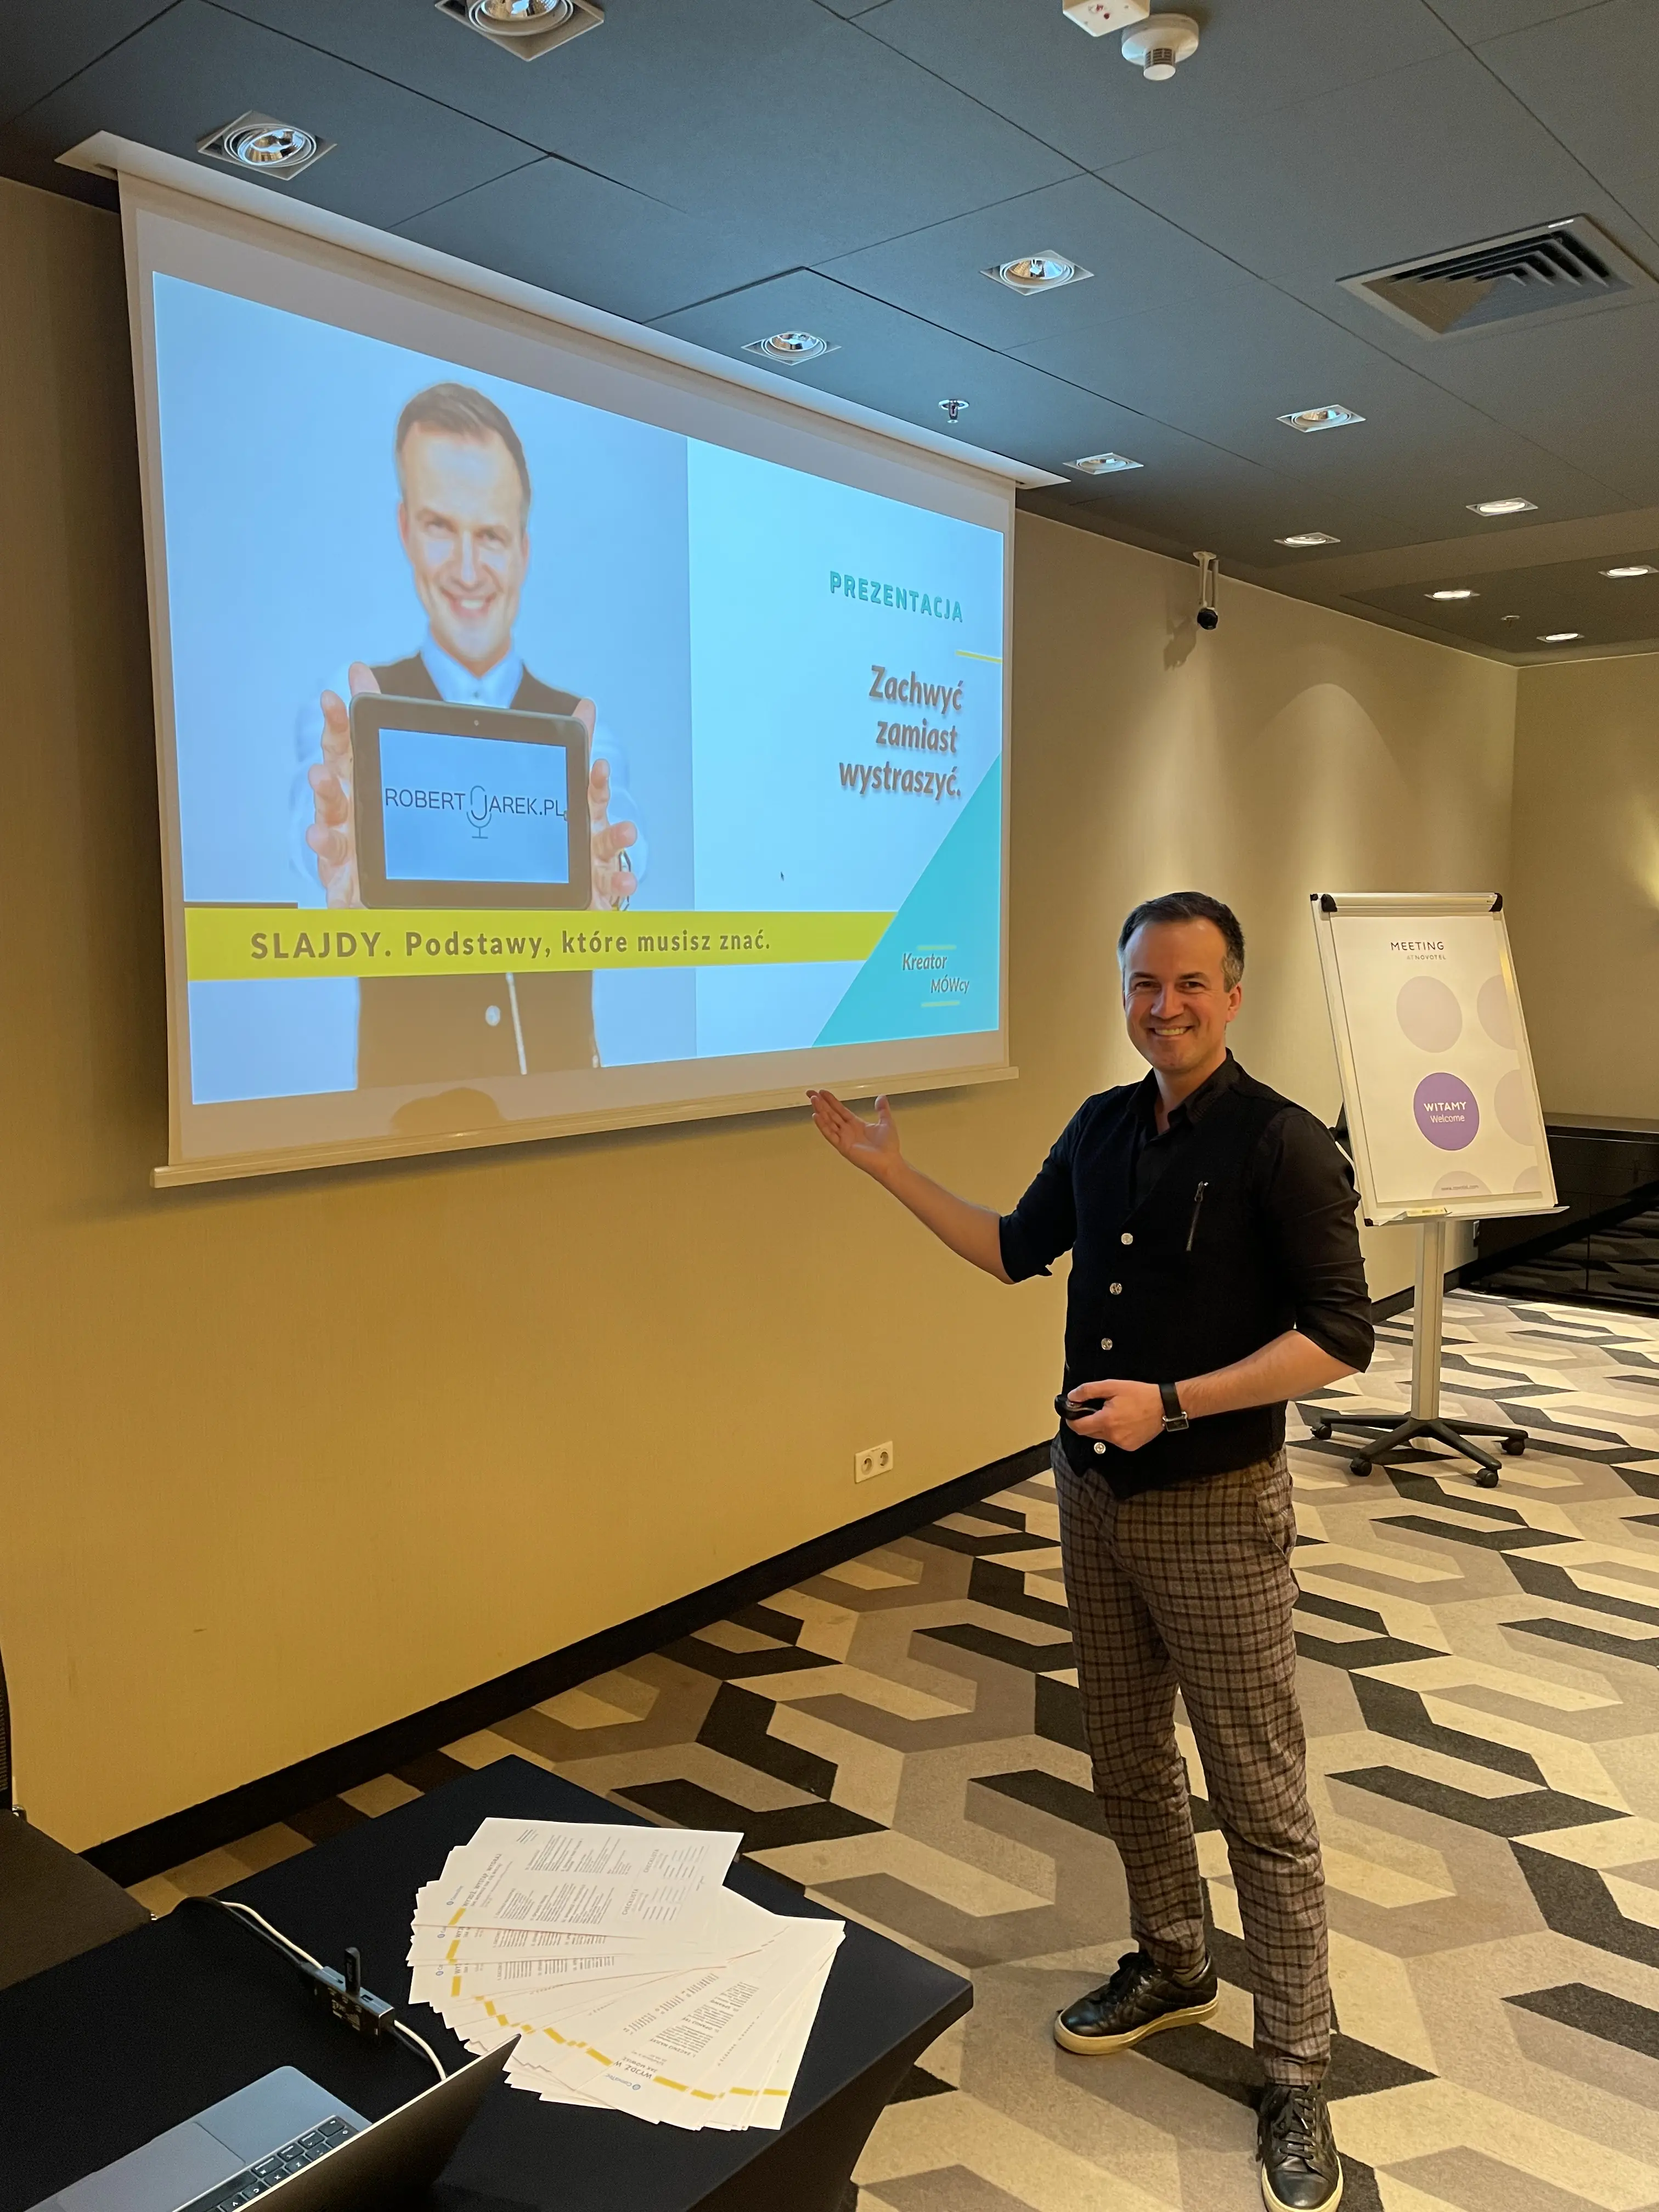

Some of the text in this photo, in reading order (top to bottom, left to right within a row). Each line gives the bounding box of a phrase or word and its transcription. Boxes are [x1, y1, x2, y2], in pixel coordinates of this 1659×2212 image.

[830, 570, 963, 623] PREZENTACJA
[869, 664, 963, 714] Zachwyć
[876, 718, 957, 753] zamiast
[839, 761, 961, 801] wystraszyć.
[385, 788, 466, 810] ROBERT
[251, 929, 770, 959] SLAJDY. Podstawy, które musisz znać.
[1390, 941, 1444, 951] MEETING
[902, 952, 947, 970] Kreator
[930, 974, 970, 994] MÓWcy
[1423, 1101, 1466, 1111] WITAMY
[1430, 1114, 1465, 1123] Welcome
[622, 1888, 639, 1915] CHECKLISTA
